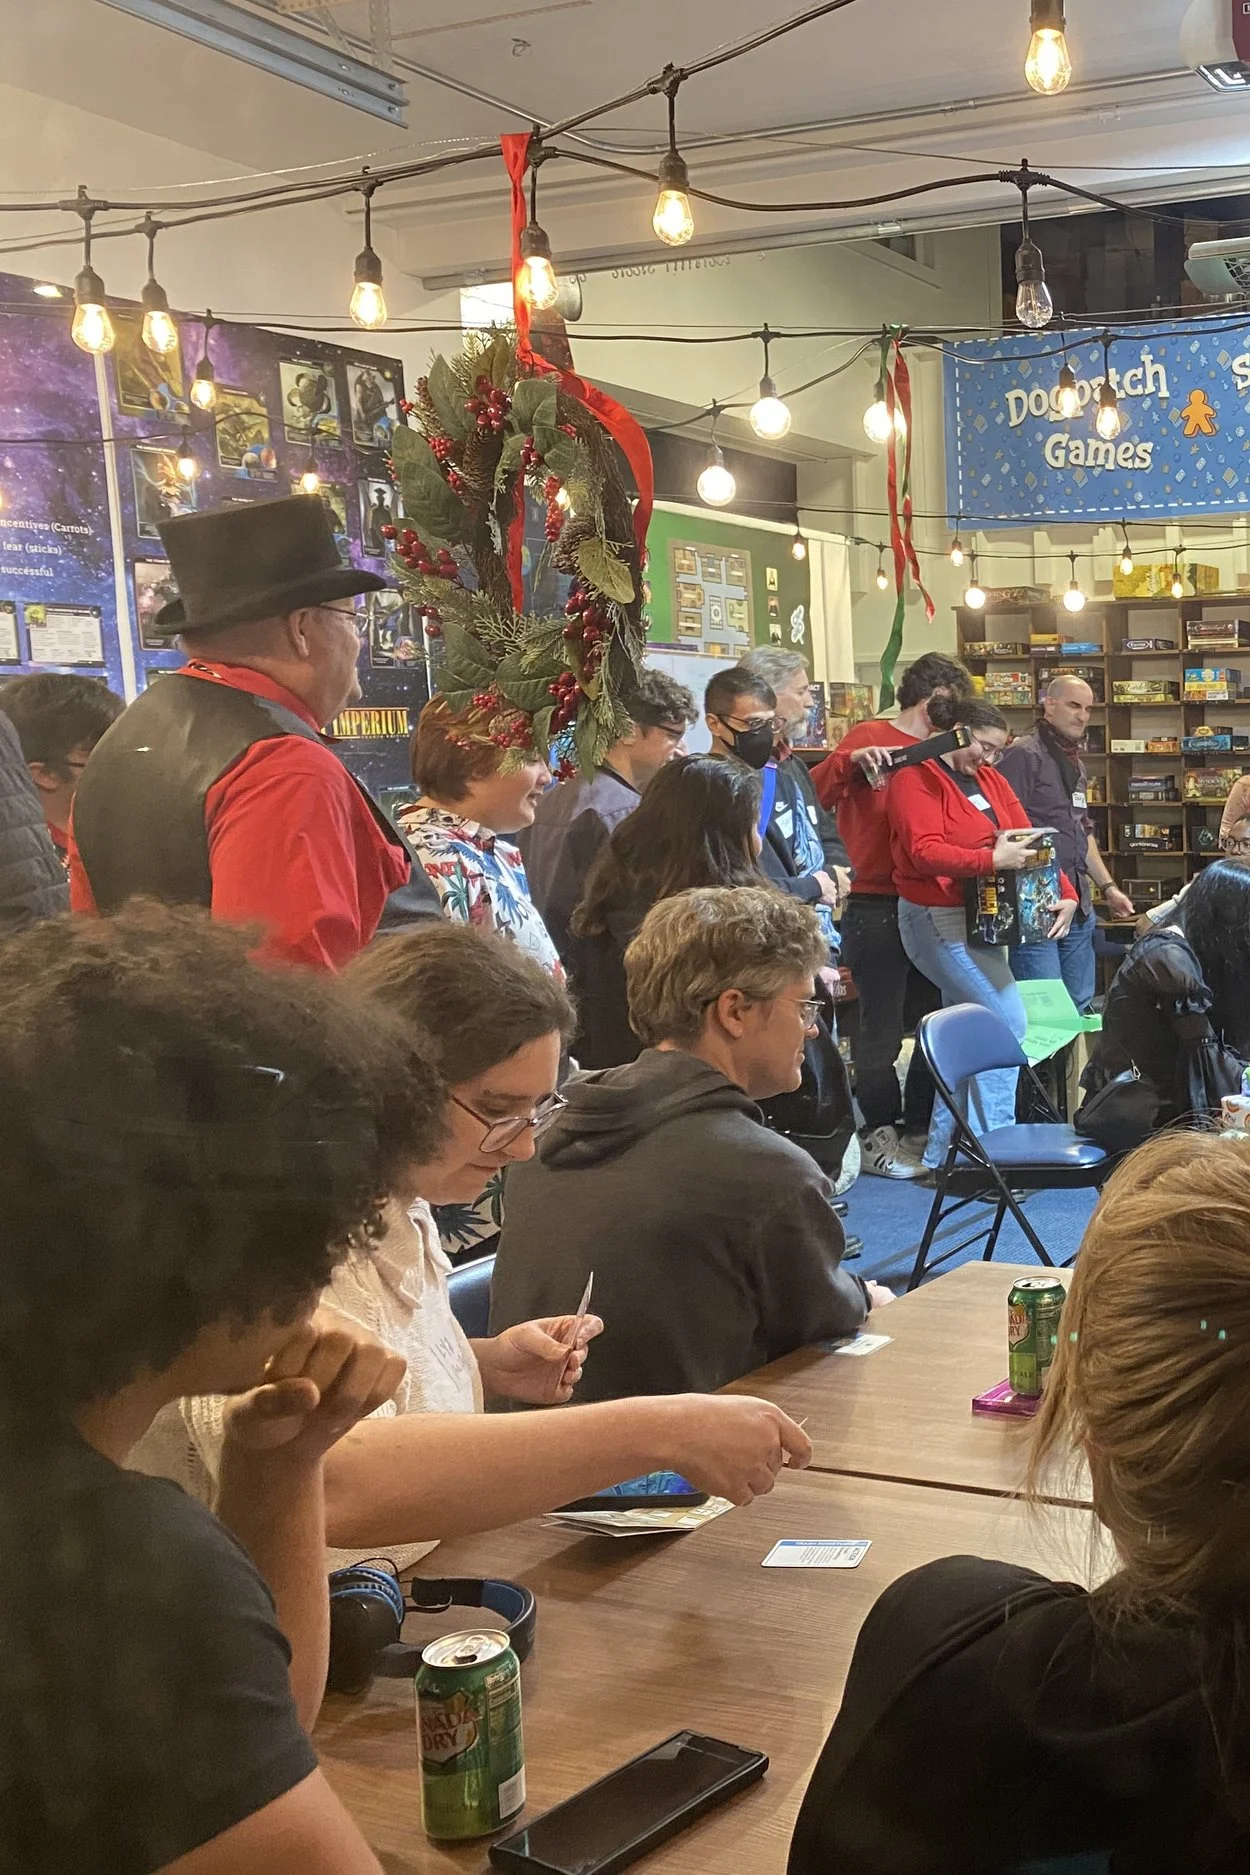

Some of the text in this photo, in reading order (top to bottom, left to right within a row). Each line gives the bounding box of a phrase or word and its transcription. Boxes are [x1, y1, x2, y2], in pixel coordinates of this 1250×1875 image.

[1044, 432, 1153, 470] Games
[0, 519, 50, 532] ncentives
[25, 543, 62, 556] (sticks)
[332, 710, 409, 736] IMPERIUM
[421, 1709, 478, 1734] NADA
[422, 1727, 459, 1752] DRY
